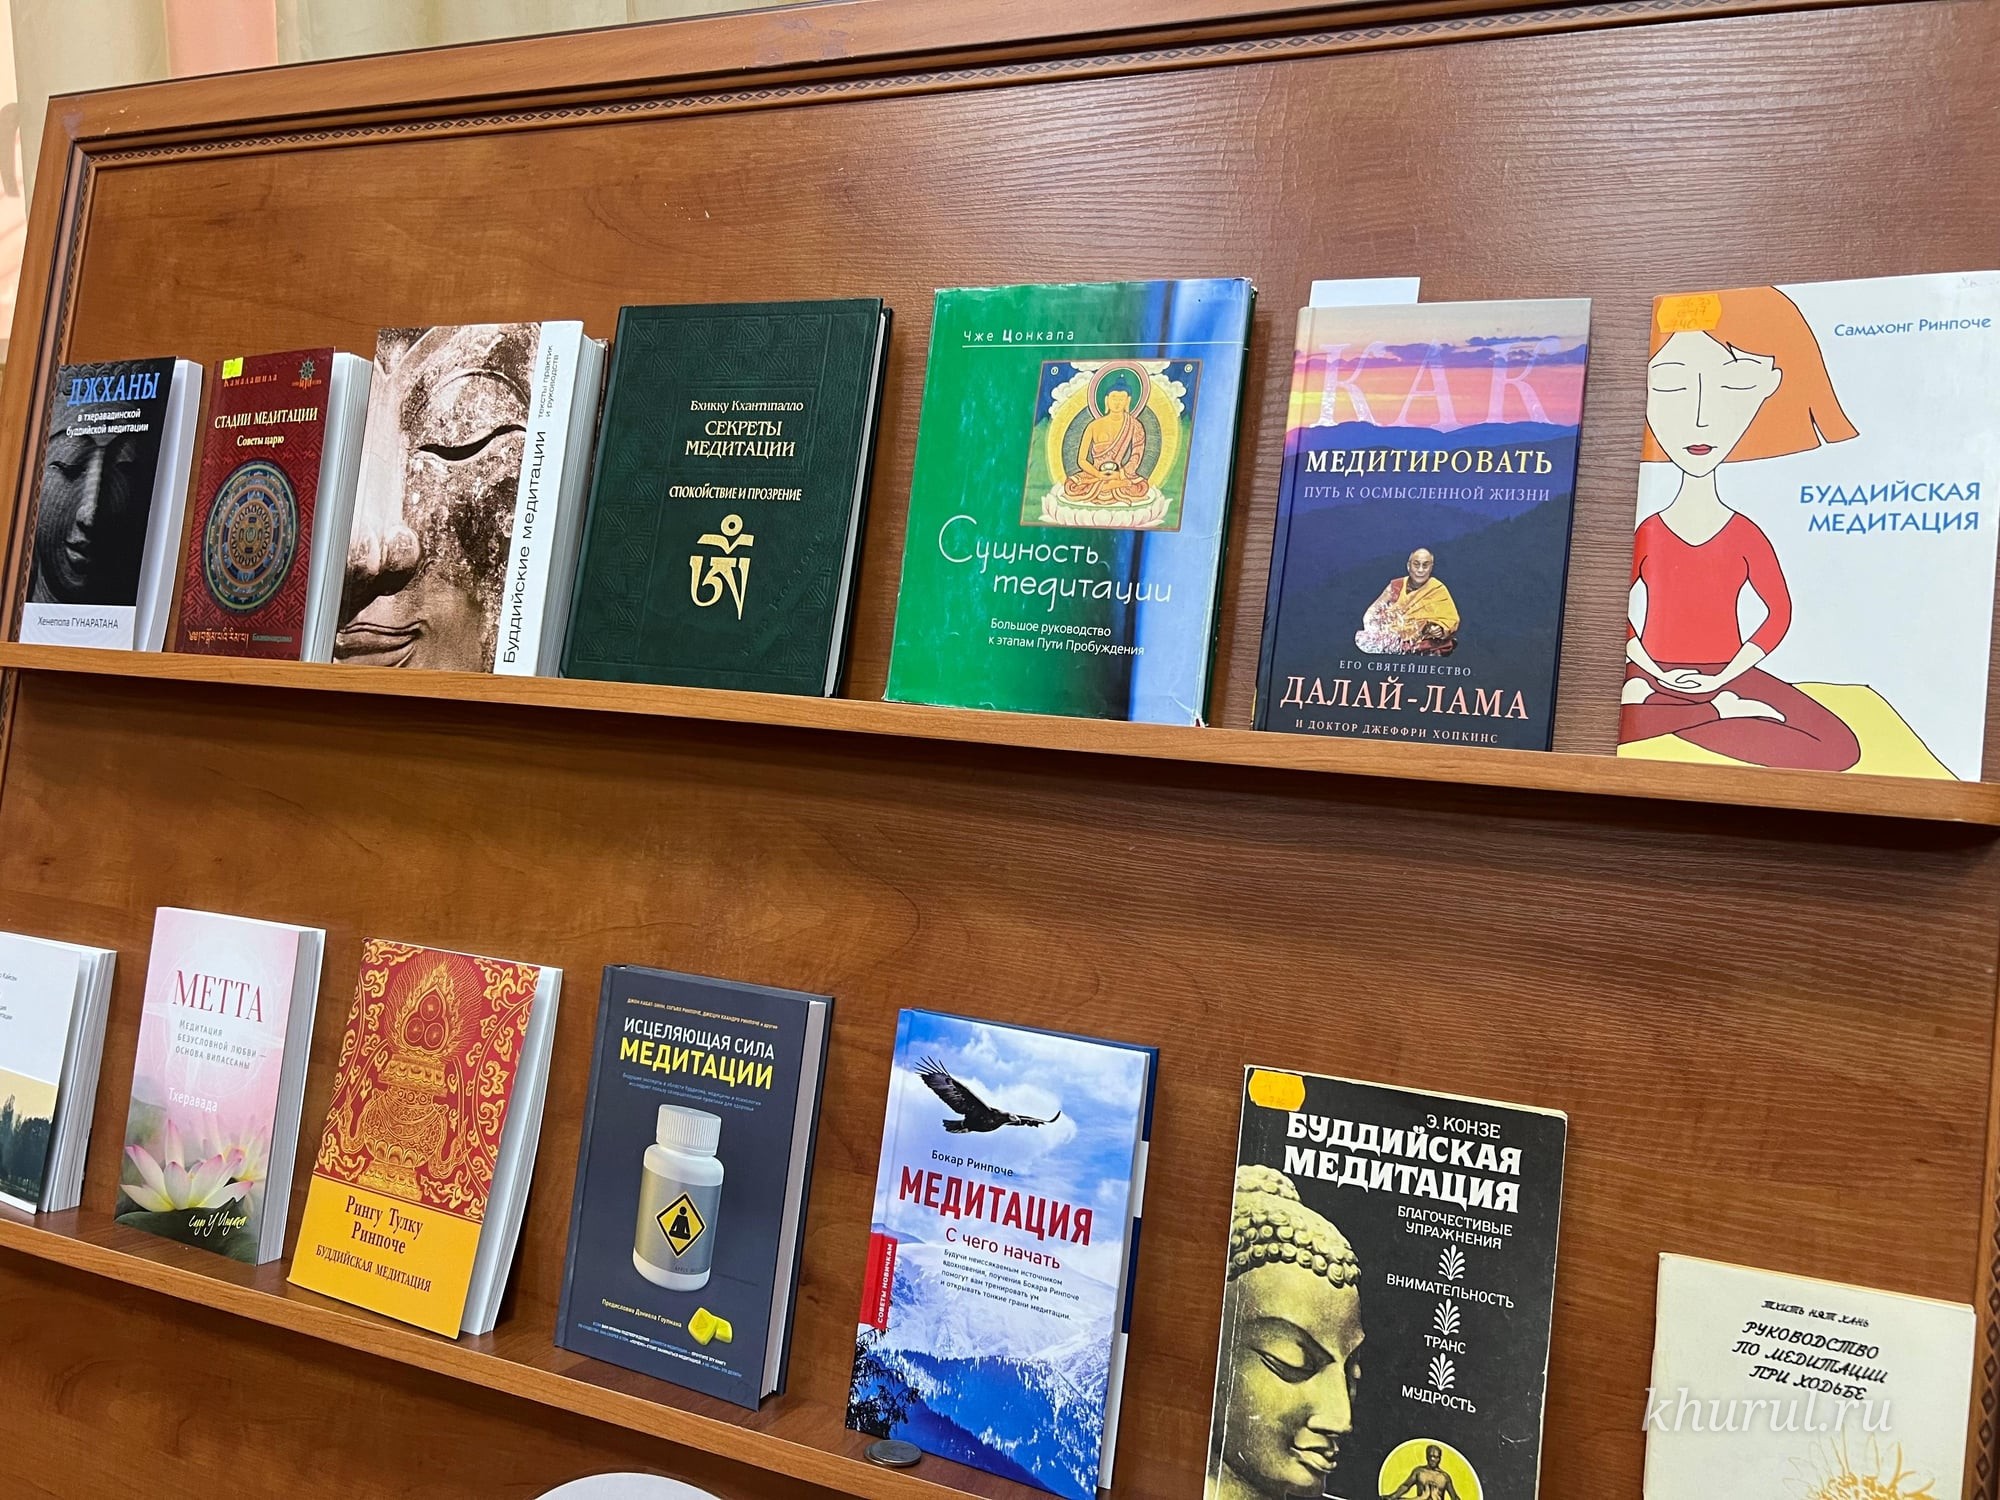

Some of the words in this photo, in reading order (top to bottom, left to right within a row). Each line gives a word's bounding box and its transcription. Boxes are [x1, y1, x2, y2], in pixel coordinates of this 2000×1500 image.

[964, 330, 994, 342] Чже
[1003, 329, 1075, 343] Цонкапа
[1834, 322, 1914, 337] Самдхонг
[1918, 318, 1992, 332] Ринпоче
[67, 373, 160, 407] ДЖХАНЫ
[1308, 338, 1561, 431] КАК
[78, 414, 82, 422] в
[84, 408, 141, 423] тхеравадинской
[214, 412, 251, 429] СТАДИИ
[253, 408, 318, 426] МЕДИТАЦИИ
[690, 400, 730, 414] Бхикку
[731, 400, 804, 412] Кхантипалло
[66, 424, 107, 438] буддийской
[107, 424, 149, 434] медитации
[237, 435, 263, 447] Советы
[264, 435, 285, 448] царю
[704, 420, 783, 436] СЕКРЕТЫ
[684, 440, 796, 459] МЕДИТАЦИИ
[1304, 449, 1553, 477] МЕДИТИРОВАТЬ
[668, 482, 738, 500] СПОКОЙСТВИЕ
[738, 488, 747, 500] И
[747, 488, 803, 501] ПРОЗРЕНИЕ
[1304, 486, 1341, 499] ПУТЬ
[1345, 486, 1356, 499] К
[1359, 485, 1485, 501] ОСМЫСЛЕННОЙ
[1489, 487, 1551, 502] ЖИЗНИ
[1799, 479, 1981, 506] БУДДИЙСКАЯ
[1808, 511, 1980, 534] МЕДИТАЦИЯ
[503, 545, 531, 664] Буддийские
[522, 430, 547, 540] медитации
[938, 514, 1099, 574] Сущность
[71, 617, 119, 629] ГУНАРАТАНА
[990, 617, 1039, 632] Большое
[1040, 621, 1112, 637] руководство
[988, 636, 994, 645] к
[996, 637, 1034, 648] этапам
[1036, 638, 1064, 651] Пути
[1065, 639, 1145, 656] Пробуждения
[1339, 660, 1363, 670] ЕГО
[1367, 660, 1472, 676] СВЯТЕЙШЕСТВО
[1279, 675, 1529, 720] ДАЛАЙ-ЛАМА
[1295, 719, 1303, 728] И
[1308, 720, 1358, 732] ДОКТОР
[1362, 723, 1427, 738] ДЖЕФФРИ
[1432, 729, 1498, 744] ХОПКИНС
[172, 970, 264, 1023] МЕТТА
[177, 1033, 228, 1052] БЕЗУСЛОВНОЙ
[231, 1045, 257, 1058] ЛЮБВИ
[624, 1017, 731, 1051] ИСЦЕЛЯЮЩАЯ
[734, 1038, 775, 1060] СИЛА
[175, 1045, 204, 1059] ОСНОВА
[206, 1052, 250, 1070] ВИПАССАНЫ
[619, 1037, 774, 1091] МЕДИТАЦИИ
[168, 1087, 218, 1112] Тхеравада
[1426, 1114, 1440, 1130] Э.
[1443, 1117, 1501, 1139] КОНЗЕ
[1287, 1111, 1523, 1176] БУДДИЙСКАЯ
[931, 1150, 964, 1167] Бокар
[966, 1154, 1014, 1177] Ринпоче
[1283, 1145, 1520, 1213] МЕДИТАЦИЯ
[345, 1195, 383, 1228] Рингу
[389, 1207, 424, 1240] Тулку
[899, 1166, 1094, 1246] МЕДИТАЦИЯ
[1397, 1205, 1513, 1236] БЛАГОЧЕСТИВЫЕ
[351, 1221, 406, 1254] Ринпоче
[945, 1227, 958, 1242] С
[963, 1233, 999, 1254] чего
[1003, 1243, 1061, 1270] начать
[1405, 1221, 1502, 1249] УПРАЖНЕНИЯ
[315, 1244, 373, 1273] БУДДИЙСКАЯ
[375, 1263, 432, 1293] МЕДИТАЦИЯ
[880, 1244, 893, 1286] НОВИЧКАМ
[942, 1259, 987, 1277] вдохновения,
[989, 1271, 1021, 1286] поучения
[1023, 1279, 1048, 1294] Бокара
[1049, 1286, 1080, 1301] Ринпоче
[944, 1248, 968, 1262] Будучи
[969, 1255, 1019, 1274] неиссякаемым
[1020, 1269, 1063, 1286] источником
[941, 1270, 969, 1283] помогут
[970, 1277, 983, 1285] вам
[985, 1280, 1028, 1299] тренировать
[1029, 1293, 1039, 1302] ум
[946, 1281, 982, 1297] открывать
[983, 1290, 1007, 1303] тонкие
[1008, 1296, 1029, 1309] грани
[1030, 1301, 1072, 1320] медитации.
[1386, 1273, 1515, 1309] ВНИМАТЕЛЬНОСТЬ
[877, 1287, 888, 1323] СОВЕТЫ
[1424, 1334, 1466, 1354] ТРАНС
[1742, 1321, 1879, 1360] РУКОВОДСТВО
[1732, 1341, 1761, 1356] ПО
[1764, 1348, 1888, 1384] МЕДИТАЦИИ
[1749, 1365, 1791, 1384] ПРИ
[1793, 1374, 1867, 1401] ХОДЬБЕ
[1401, 1384, 1477, 1414] МУДРОСТЬ
